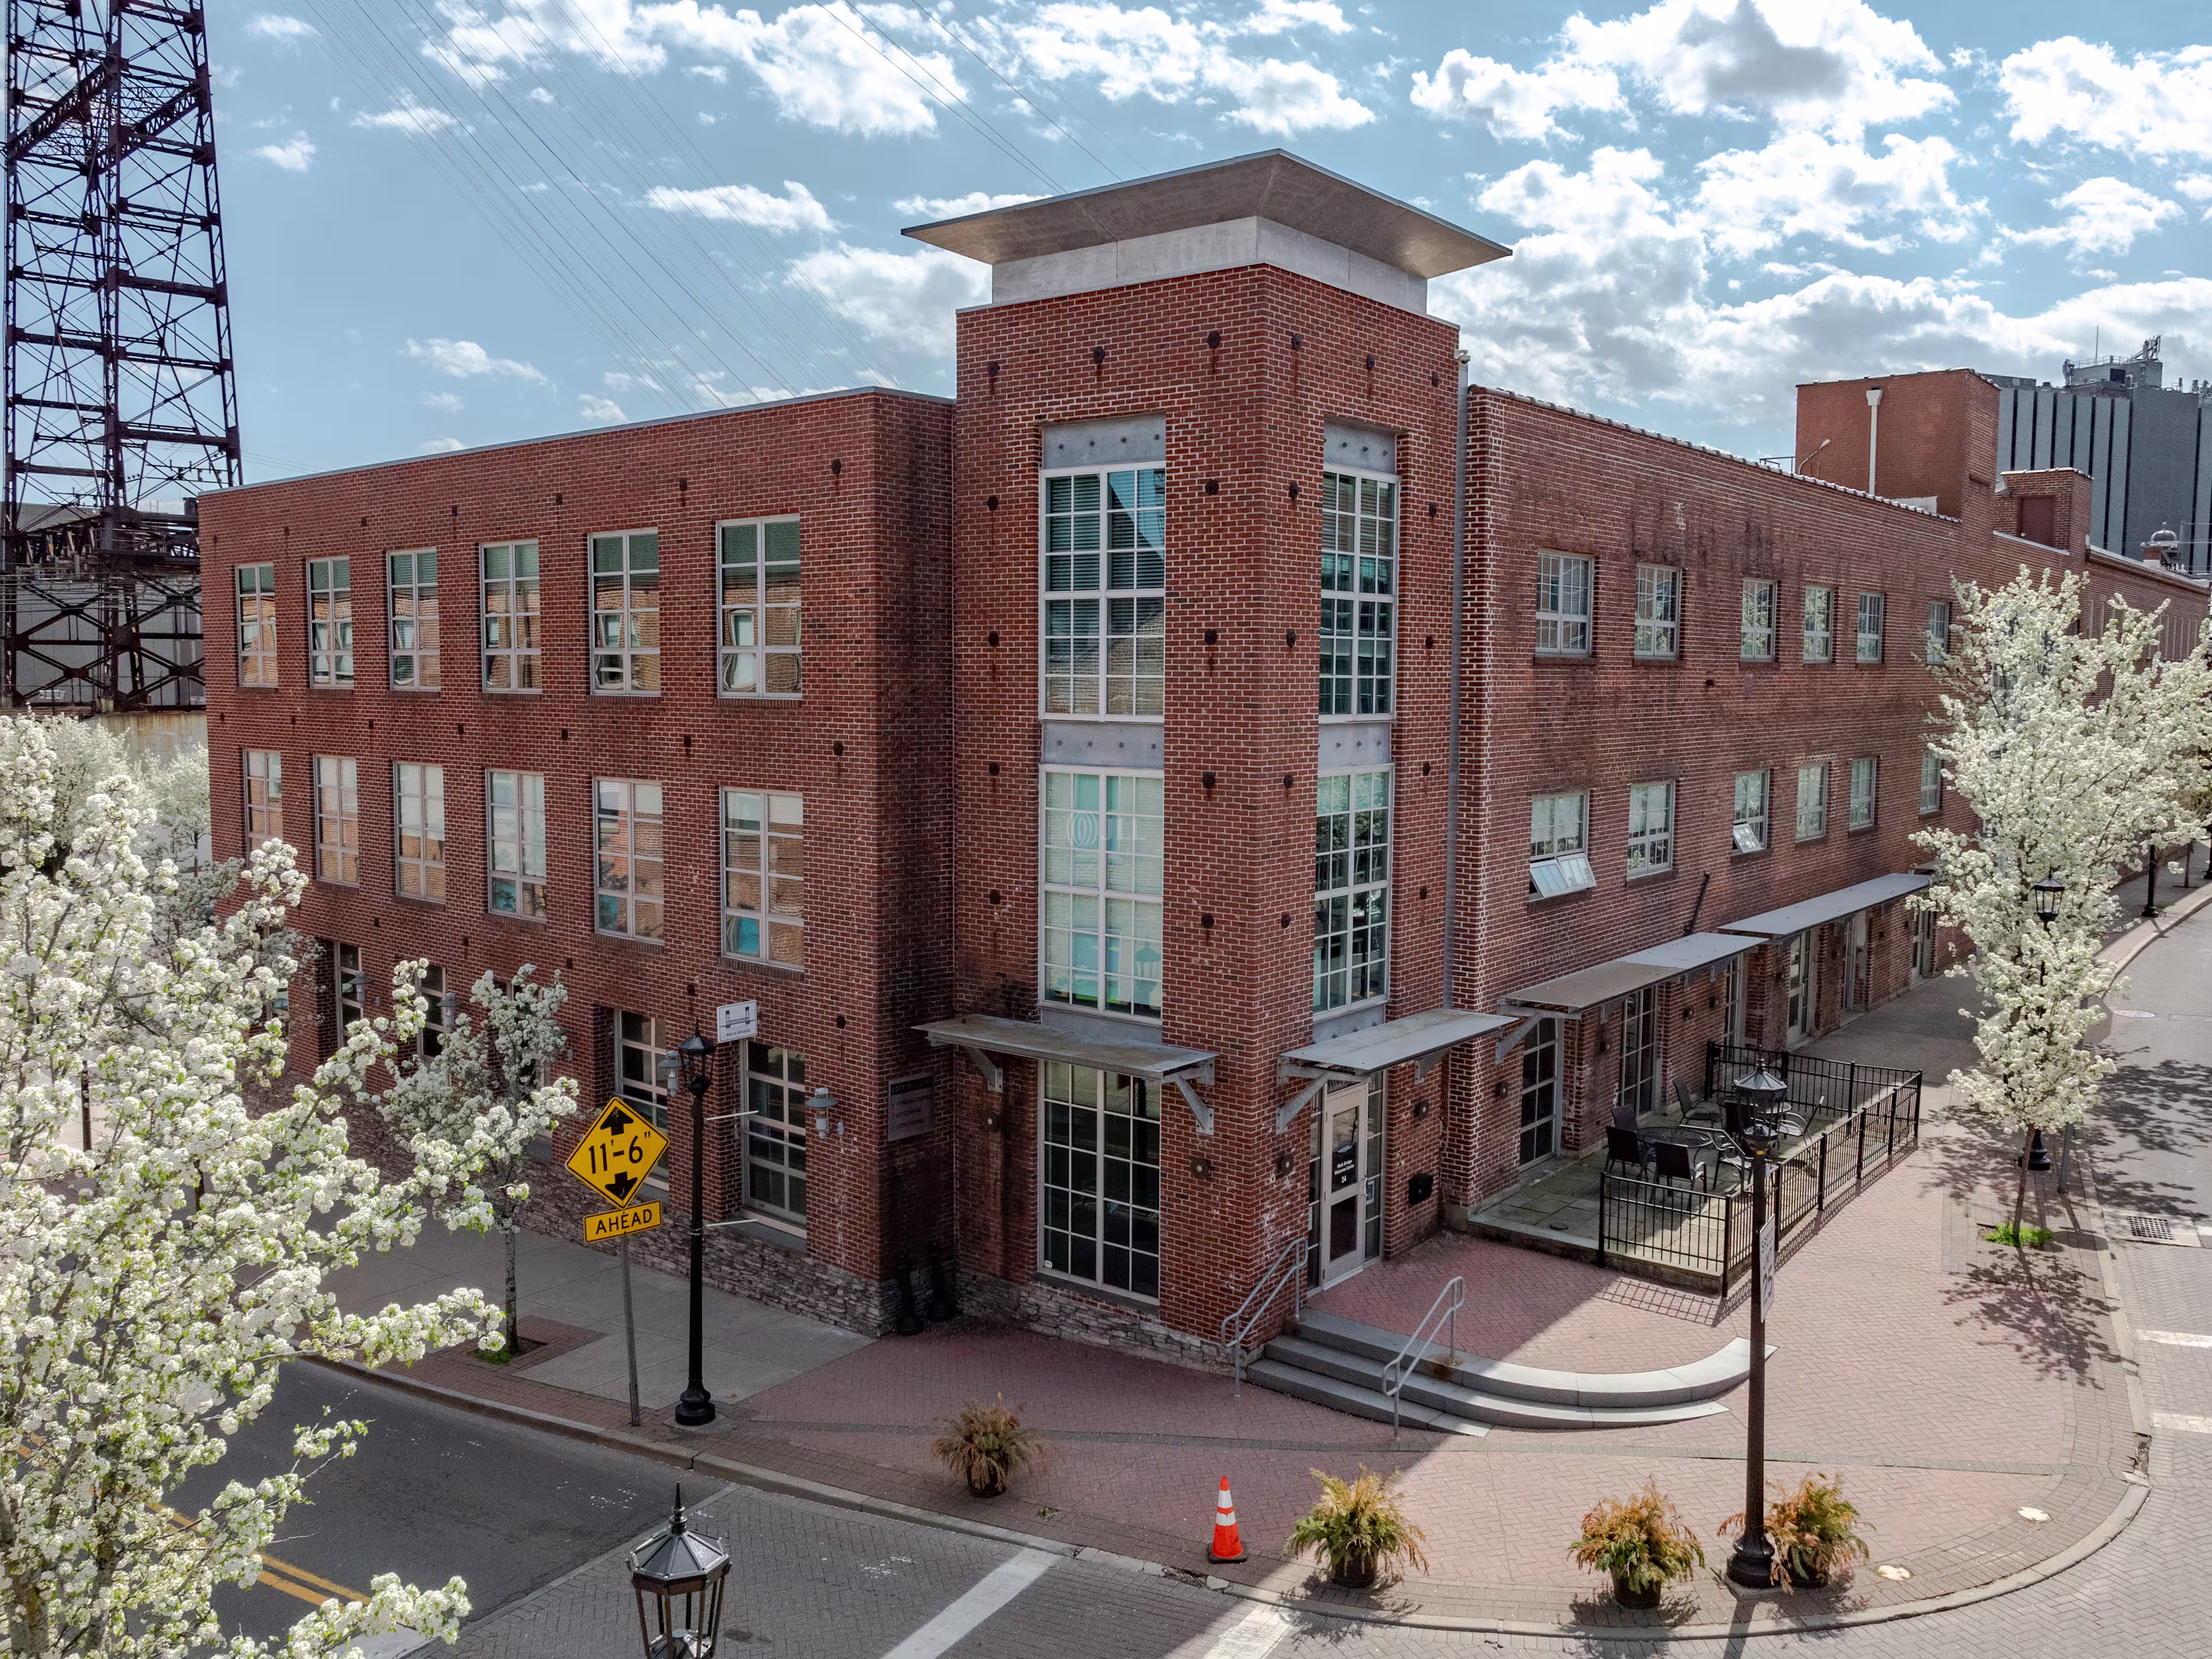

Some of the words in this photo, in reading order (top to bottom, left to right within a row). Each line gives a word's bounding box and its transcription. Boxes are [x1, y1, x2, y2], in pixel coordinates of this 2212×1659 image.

[892, 1085, 905, 1093] LOCK
[1341, 1175, 1347, 1183] 24
[596, 1209, 652, 1235] AHEAD
[1762, 1228, 1773, 1253] SPEED
[1763, 1247, 1772, 1270] LIMIT
[1763, 1264, 1772, 1306] 25
